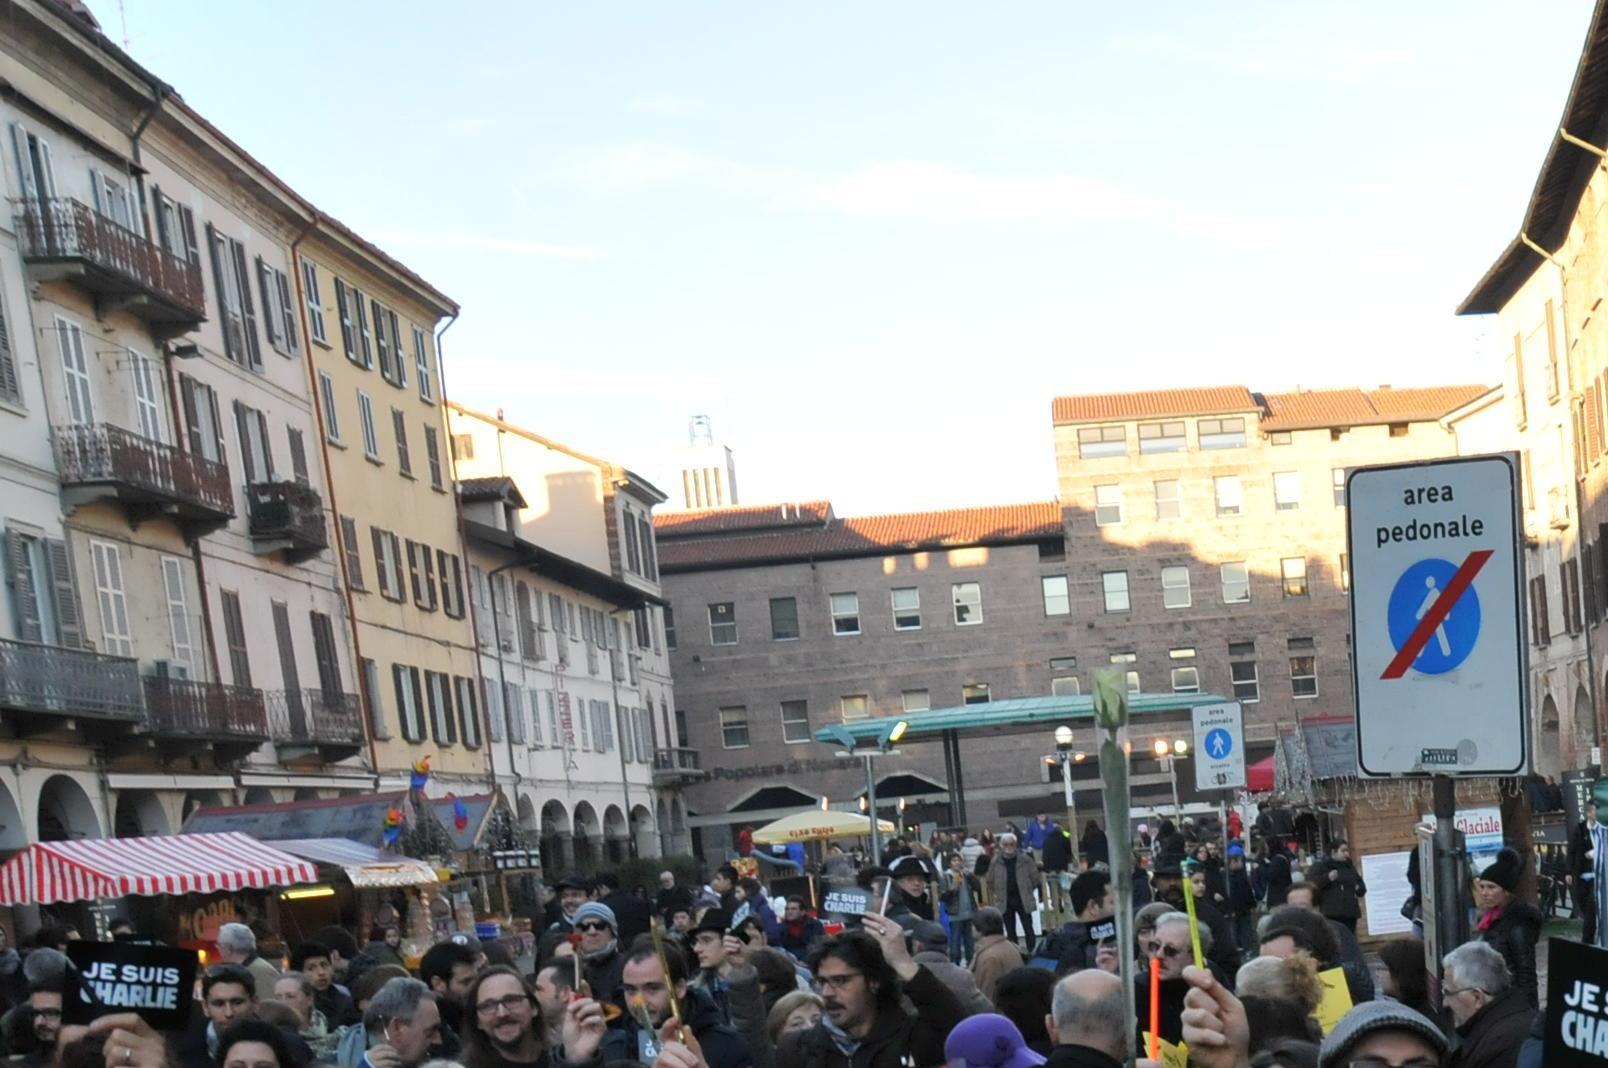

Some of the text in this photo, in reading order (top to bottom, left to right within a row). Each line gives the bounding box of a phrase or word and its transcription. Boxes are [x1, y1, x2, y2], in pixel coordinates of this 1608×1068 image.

[1404, 485, 1453, 505] area
[1377, 515, 1484, 548] pedonale
[1576, 784, 1585, 820] MERCA
[1456, 816, 1500, 835] Glaciale
[824, 901, 866, 914] CHARLIE
[825, 892, 866, 903] JE SUIS
[82, 962, 179, 984] JE SUIS
[1564, 980, 1600, 1013] JE
